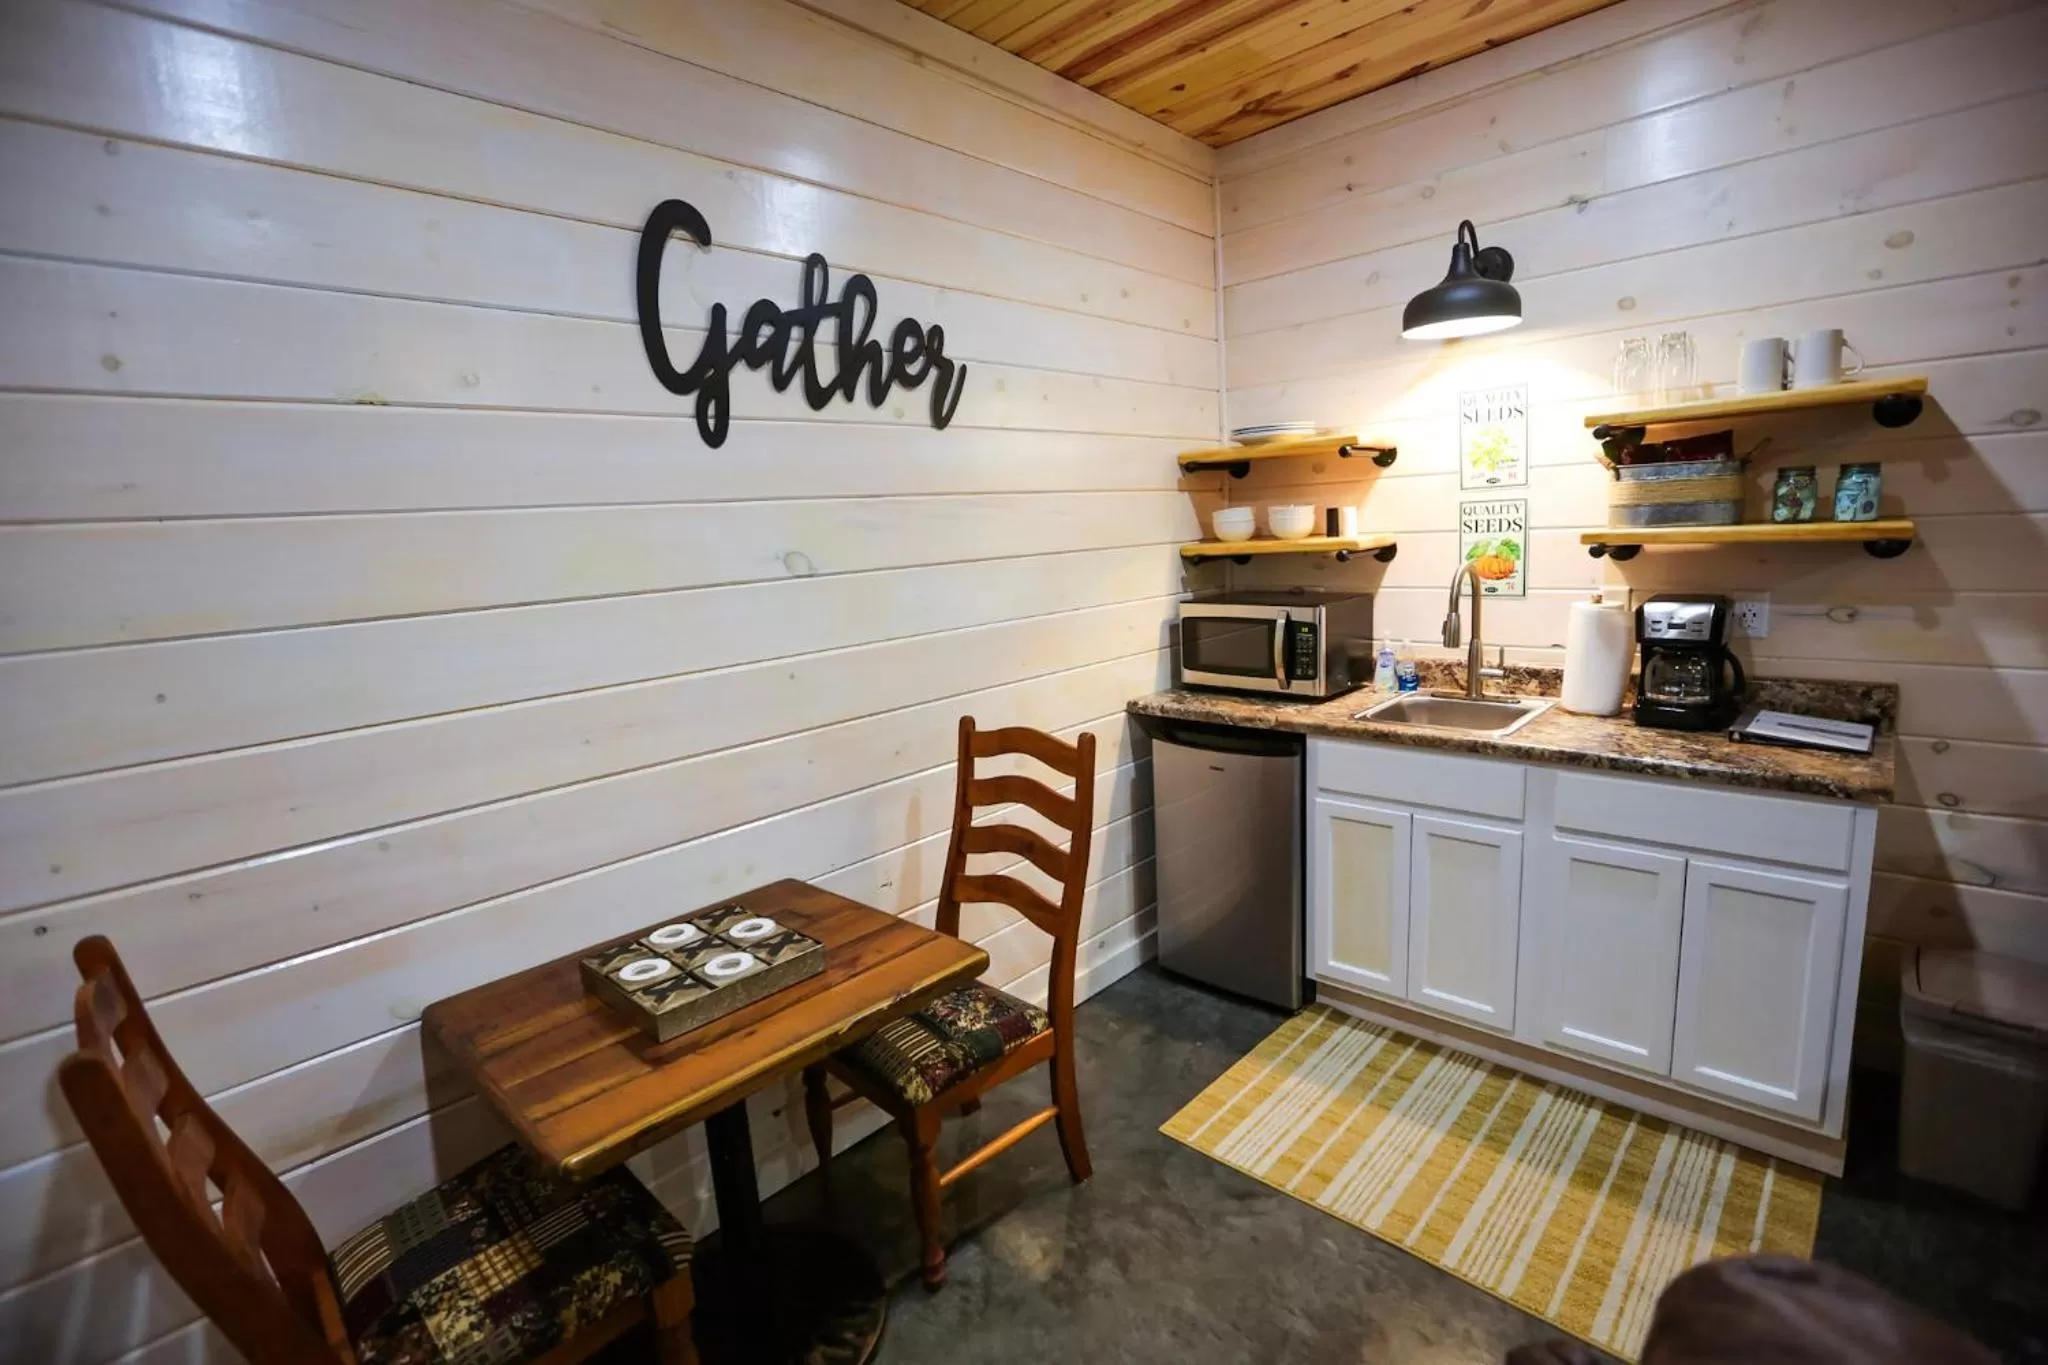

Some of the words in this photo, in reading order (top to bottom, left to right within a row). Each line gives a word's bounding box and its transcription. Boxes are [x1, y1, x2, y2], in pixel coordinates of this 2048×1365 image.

[637, 199, 967, 449] Gather
[1463, 403, 1525, 423] SEEDS
[1463, 503, 1524, 516] QUALITY
[1463, 517, 1523, 534] SEEDS
